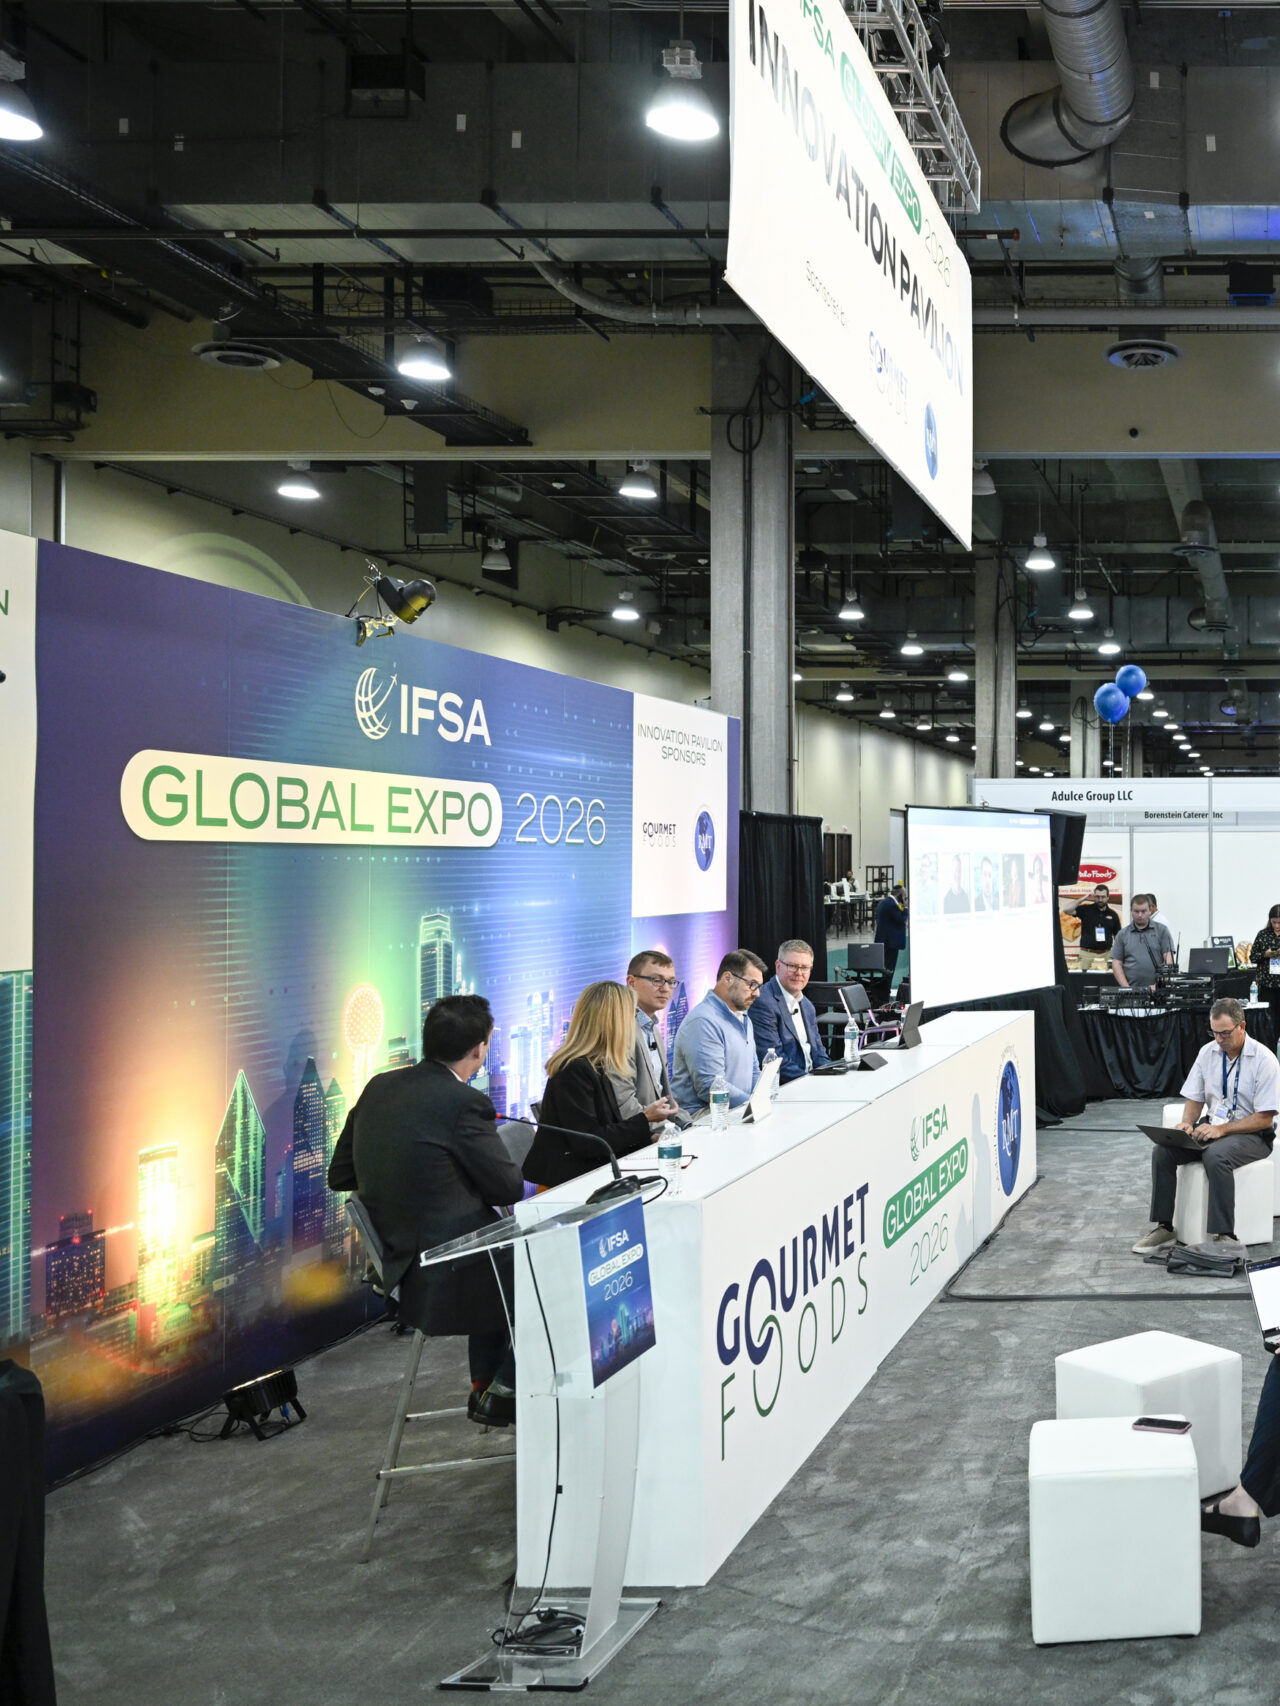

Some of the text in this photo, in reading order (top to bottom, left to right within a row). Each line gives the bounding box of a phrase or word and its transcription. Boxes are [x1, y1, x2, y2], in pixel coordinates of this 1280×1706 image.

[749, 0, 896, 290] INNOVATION
[900, 249, 963, 397] PAVILION
[893, 163, 920, 226] EXPO
[925, 218, 951, 288] 2026
[400, 684, 492, 746] IFSA
[637, 723, 723, 753] INNOVATION PAVILION
[661, 745, 706, 766] SPONSORS
[142, 764, 606, 846] GLOBAL EXPO 2026
[1051, 790, 1133, 803] Adulce Group LLC
[1144, 810, 1223, 819] Borenstein Caterer Inc
[642, 822, 677, 838] GOURMET
[921, 1103, 949, 1149] IFSA
[886, 1143, 966, 1240] GLOBAL EXPO
[607, 1228, 630, 1252] IFSA
[910, 1212, 949, 1286] 2026
[589, 1245, 643, 1285] GLOBAL EXPO
[603, 1271, 633, 1302] 2026
[716, 1182, 869, 1366] GOURMET
[721, 1251, 869, 1461] FOODS
